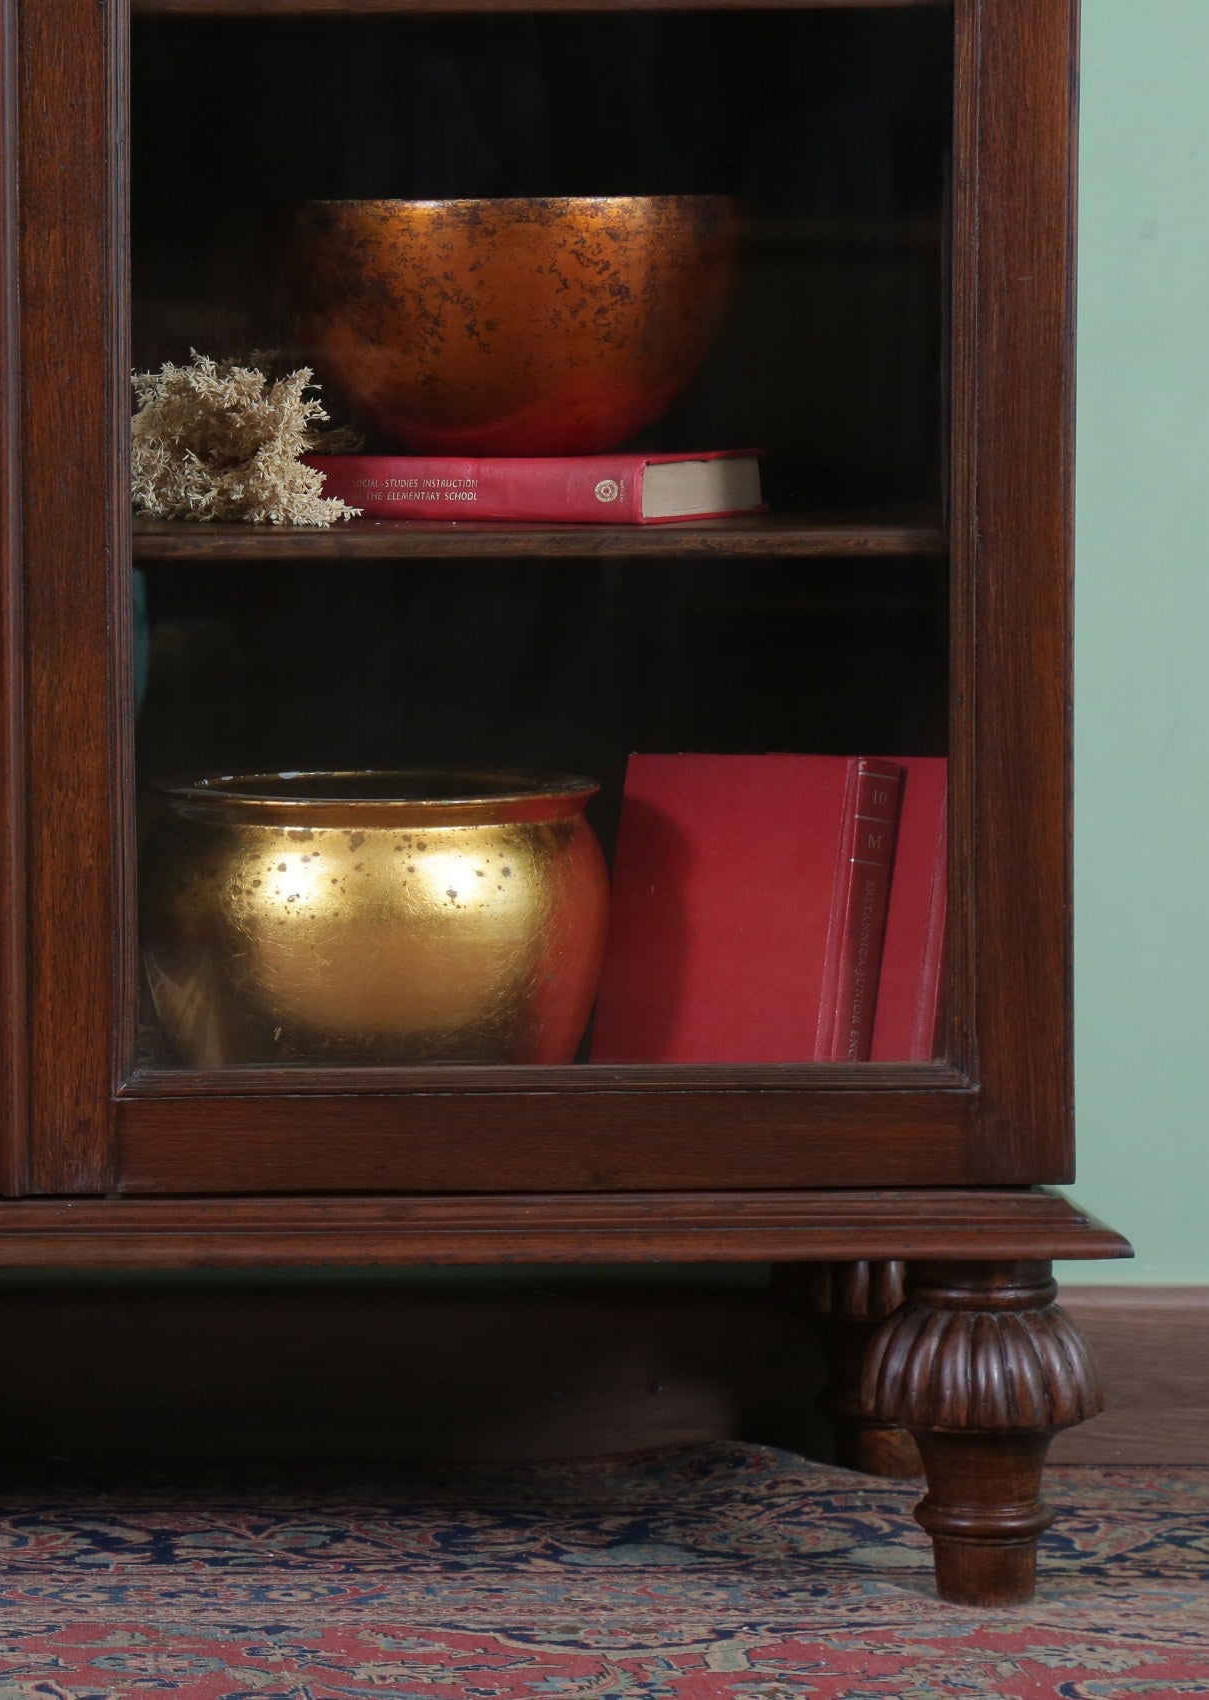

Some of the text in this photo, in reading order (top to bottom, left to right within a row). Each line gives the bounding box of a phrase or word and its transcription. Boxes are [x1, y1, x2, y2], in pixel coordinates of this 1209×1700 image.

[422, 478, 478, 489] INSTRUCTION
[366, 491, 383, 501] THE
[386, 491, 441, 501] ELEMENTARY
[444, 490, 478, 501] SCHOOL
[872, 789, 888, 807] 10
[867, 833, 884, 849] M
[858, 880, 875, 966] BRITANNICA
[851, 967, 867, 1025] JUNIOR
